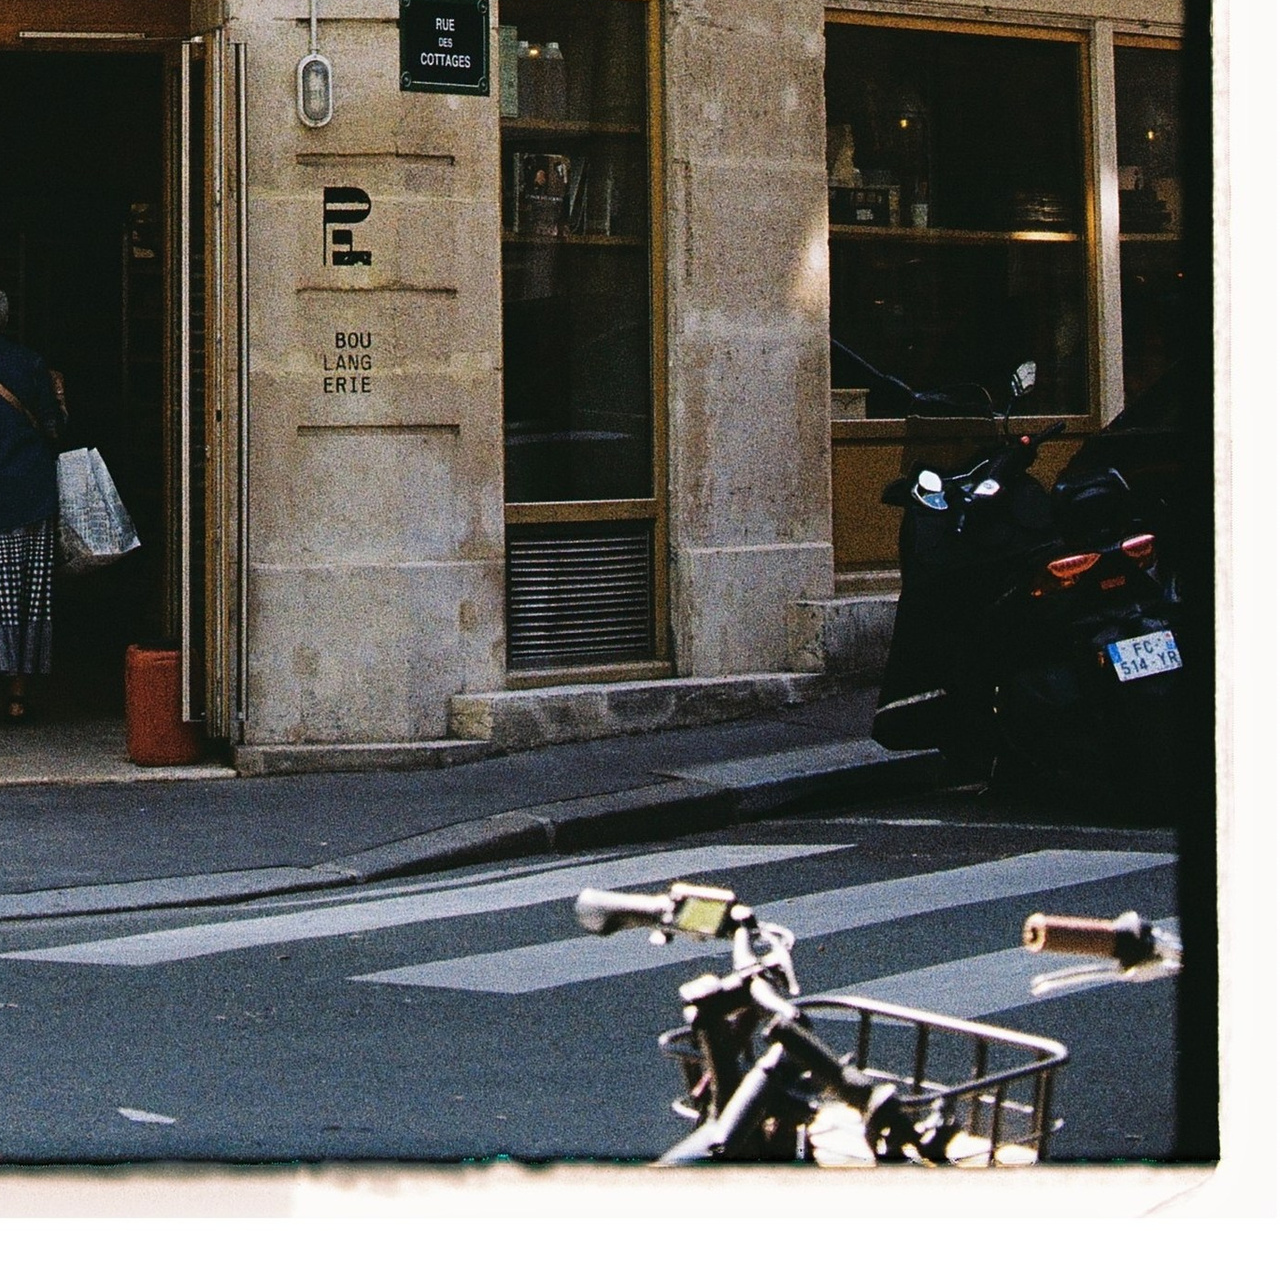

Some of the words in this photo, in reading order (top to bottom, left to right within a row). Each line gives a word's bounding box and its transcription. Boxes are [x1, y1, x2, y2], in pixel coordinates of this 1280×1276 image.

[435, 17, 455, 32] RUE
[438, 37, 453, 48] DES
[420, 52, 471, 69] COTTAGES
[335, 331, 372, 349] BOU
[323, 354, 372, 371] LANG
[323, 376, 372, 394] ERIE
